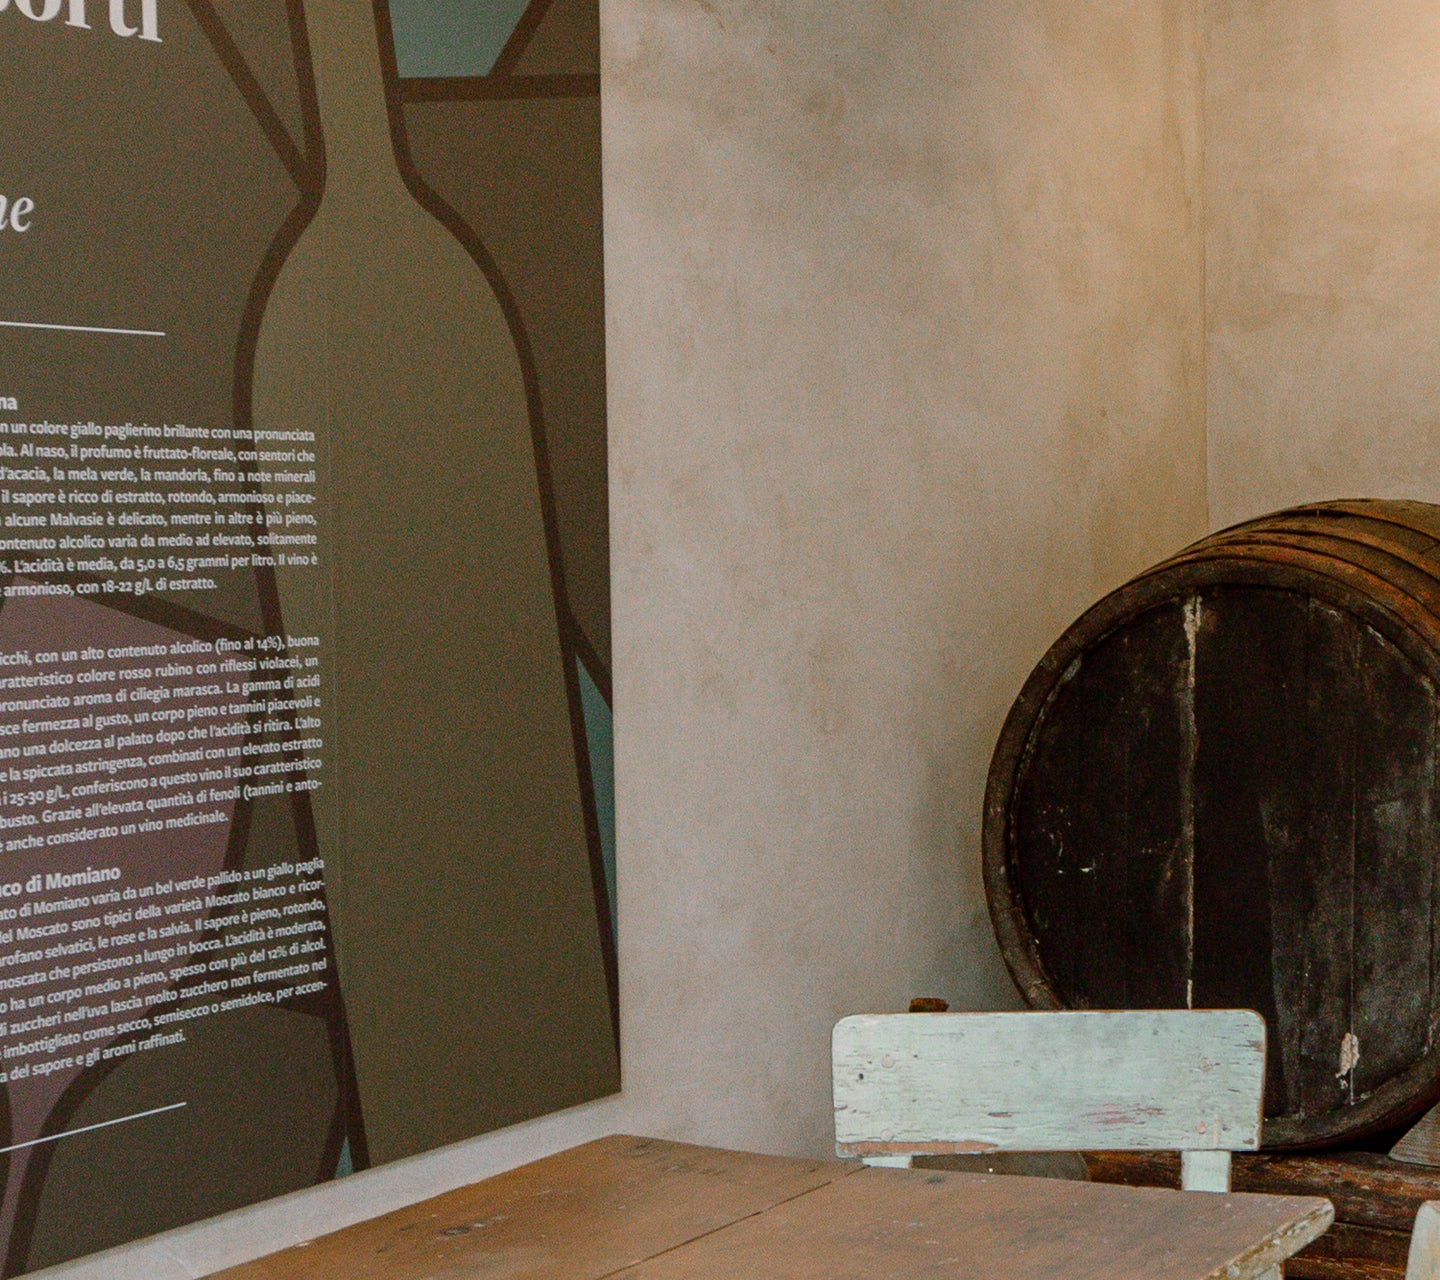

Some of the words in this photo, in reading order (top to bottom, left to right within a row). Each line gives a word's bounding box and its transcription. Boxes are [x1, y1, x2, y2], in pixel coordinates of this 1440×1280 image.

[10, 422, 28, 435] un
[30, 420, 68, 435] colore
[70, 421, 102, 439] giallo
[105, 423, 161, 440] paglierino
[164, 424, 209, 439] brillante
[210, 427, 232, 440] con
[232, 429, 253, 440] una
[254, 428, 315, 443] pronunciata
[6, 834, 44, 851] anche
[47, 826, 118, 846] considerato
[120, 823, 137, 836] un
[138, 819, 163, 833] vino
[25, 873, 42, 894] di
[46, 866, 120, 890] Momiano
[9, 1063, 30, 1081] del
[32, 1057, 73, 1076] sapore
[75, 1054, 84, 1067] e
[85, 1046, 101, 1068] gli
[103, 1040, 136, 1059] aromi
